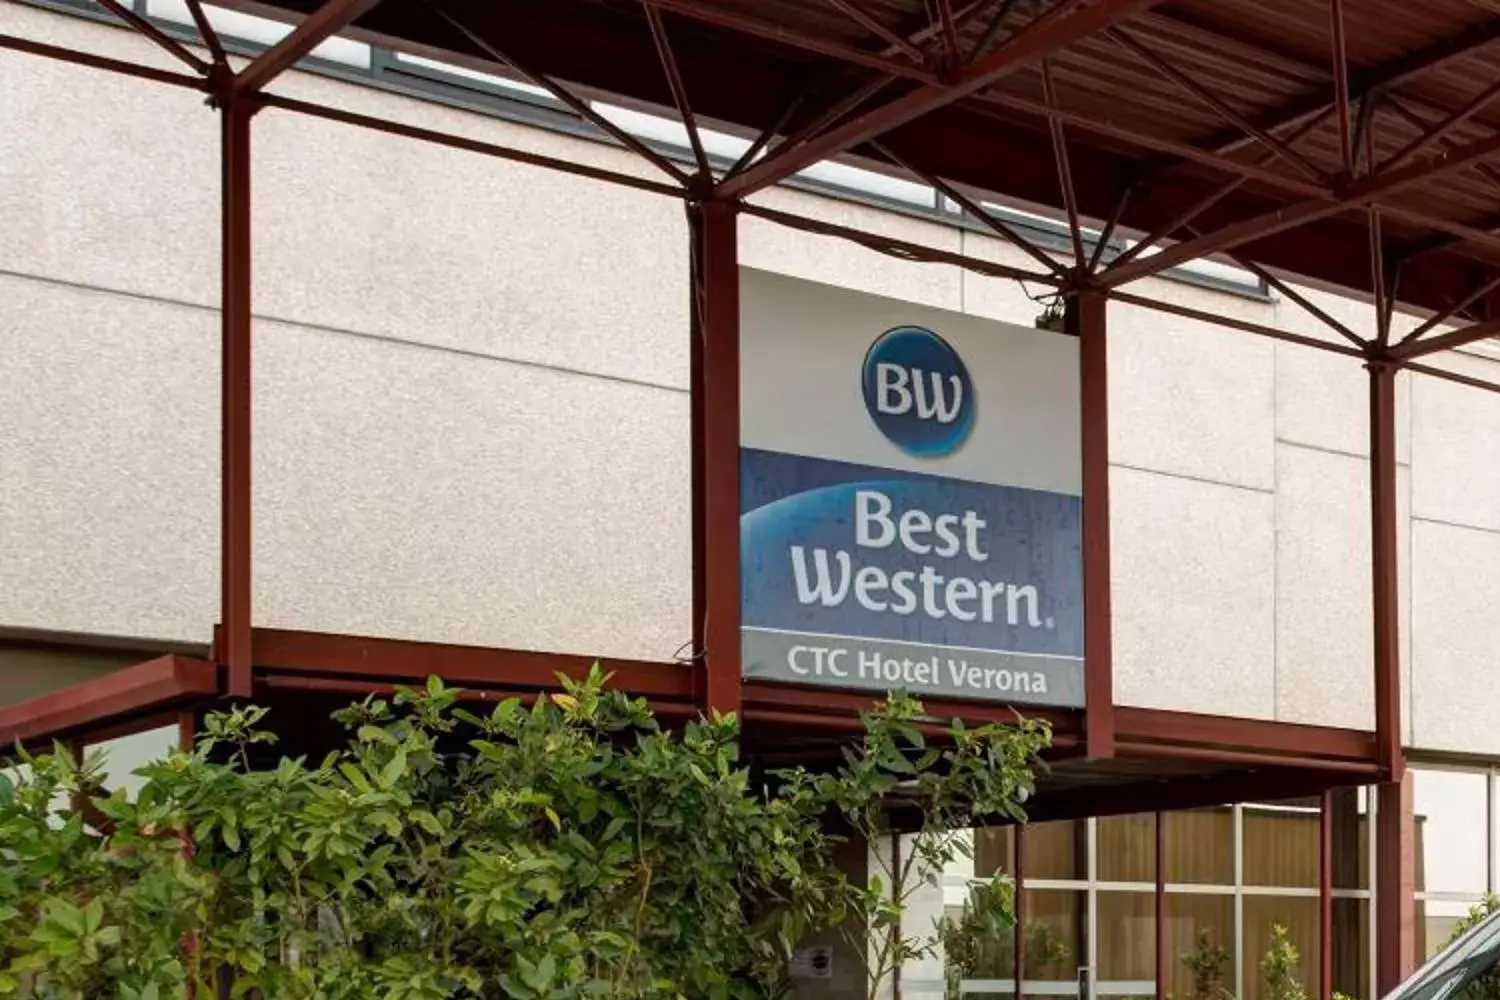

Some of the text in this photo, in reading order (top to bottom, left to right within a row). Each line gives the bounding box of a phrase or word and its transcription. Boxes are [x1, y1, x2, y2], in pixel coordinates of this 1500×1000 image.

[876, 362, 963, 424] BW
[855, 490, 989, 562] Best
[787, 645, 1048, 694] CTC Hotel Verona
